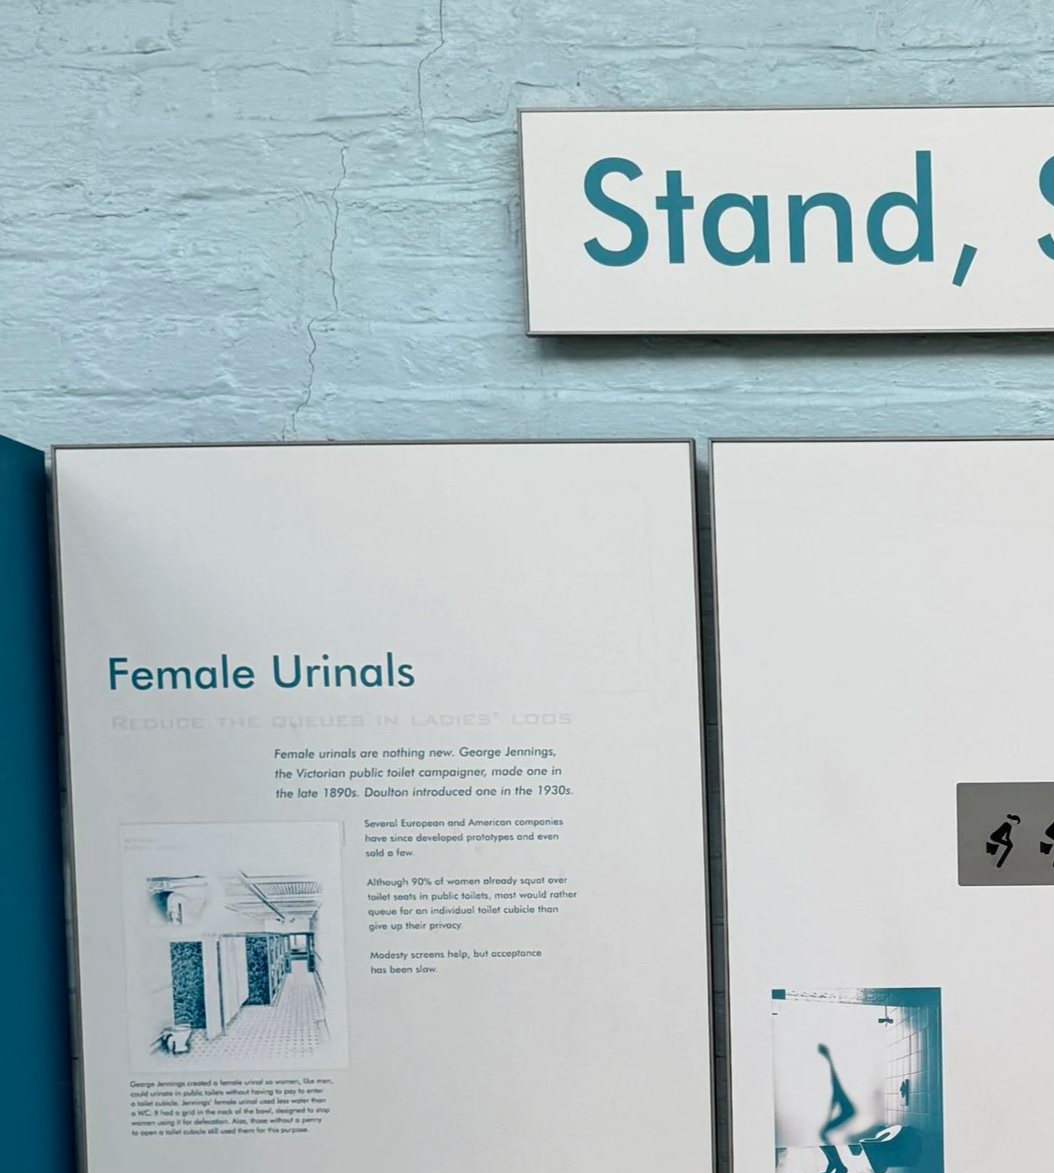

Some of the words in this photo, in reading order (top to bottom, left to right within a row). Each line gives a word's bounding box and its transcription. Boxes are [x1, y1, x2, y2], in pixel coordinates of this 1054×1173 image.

[583, 152, 976, 288] Stand,
[109, 655, 255, 689] Female
[272, 652, 415, 687] Urinals
[216, 715, 260, 730] THE
[376, 713, 399, 728] IN
[511, 712, 573, 727] LOOS
[273, 748, 315, 759] Female
[318, 748, 356, 758] urinals
[359, 750, 378, 758] are
[382, 747, 425, 759] nothing
[428, 749, 454, 757] new.
[458, 746, 501, 759] George
[504, 746, 556, 758] Jennings,
[274, 768, 292, 778] the
[295, 768, 345, 778] Victorian
[349, 767, 383, 780] public
[386, 766, 415, 777] toilet
[417, 767, 486, 779] campaigner,
[491, 765, 523, 776] made
[551, 765, 562, 775] in
[275, 788, 293, 798] the
[297, 787, 318, 798] late
[323, 787, 359, 797] 1890s.
[364, 786, 408, 797] Doulton
[412, 785, 472, 796] introduced
[475, 788, 497, 796] one
[500, 786, 511, 795] in
[514, 785, 532, 795] the
[538, 784, 573, 795] 1930s.
[363, 818, 398, 827] Several
[400, 818, 445, 828] European
[446, 818, 465, 826] and
[467, 818, 511, 826] American
[364, 834, 387, 842] have
[389, 834, 413, 842] since
[415, 833, 463, 842] developed
[466, 833, 514, 842] prototypes
[516, 831, 534, 840] and
[365, 848, 384, 857] sold
[395, 847, 415, 856] few.
